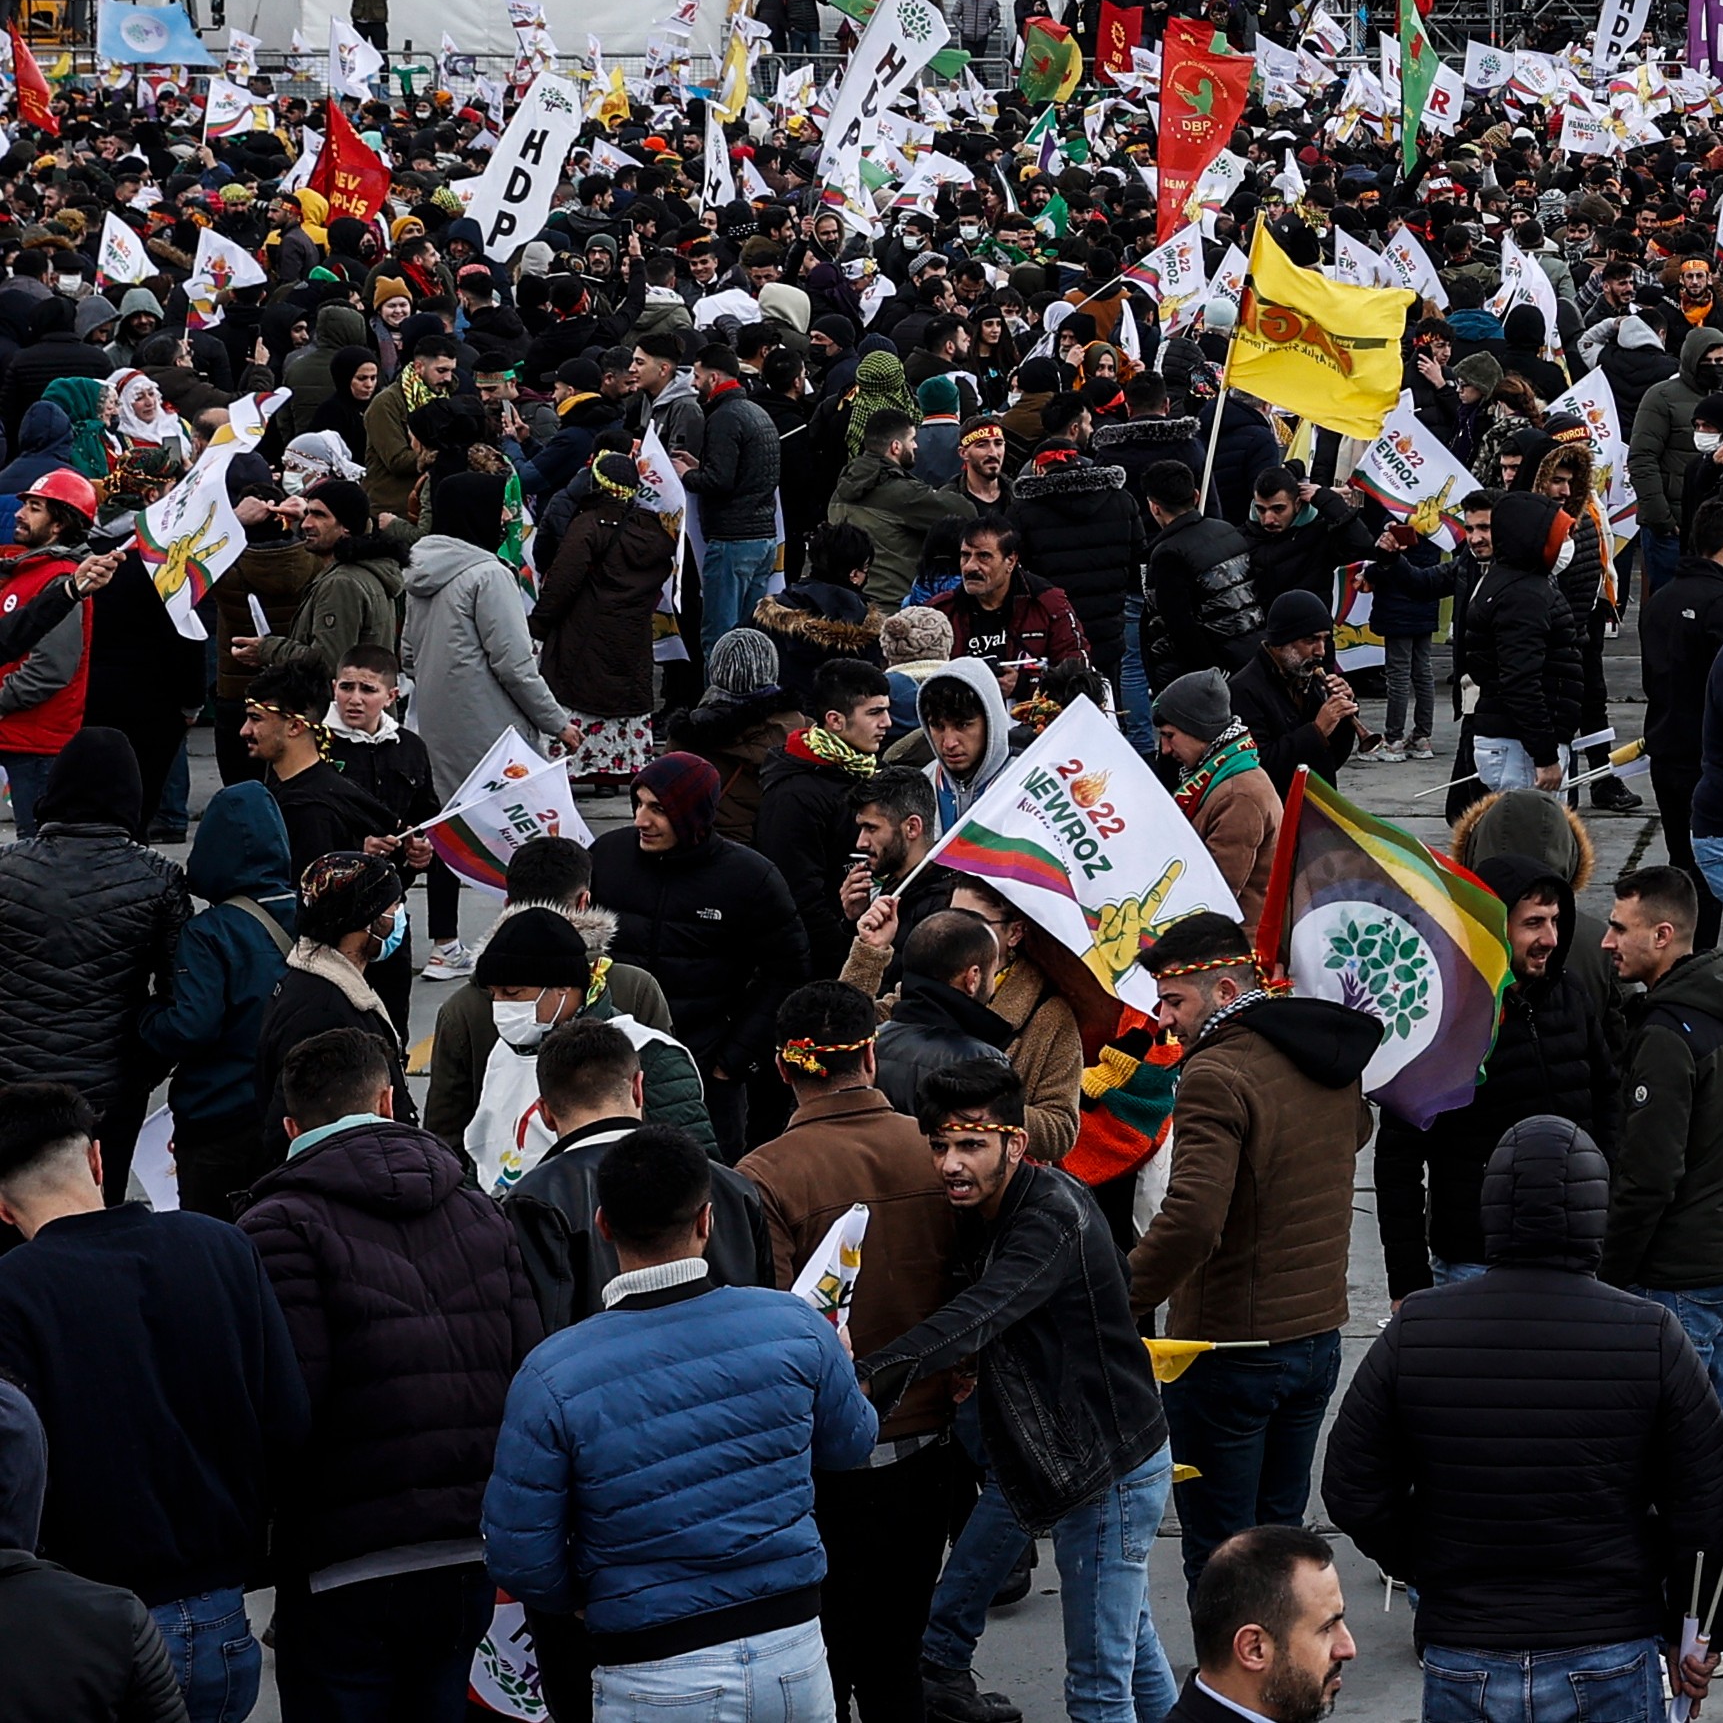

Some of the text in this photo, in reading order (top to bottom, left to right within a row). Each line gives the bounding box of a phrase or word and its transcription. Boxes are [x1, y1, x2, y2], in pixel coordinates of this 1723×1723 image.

[1182, 120, 1212, 132] DBP
[486, 128, 554, 248] HDP
[1018, 765, 1114, 881] NEWROZ
